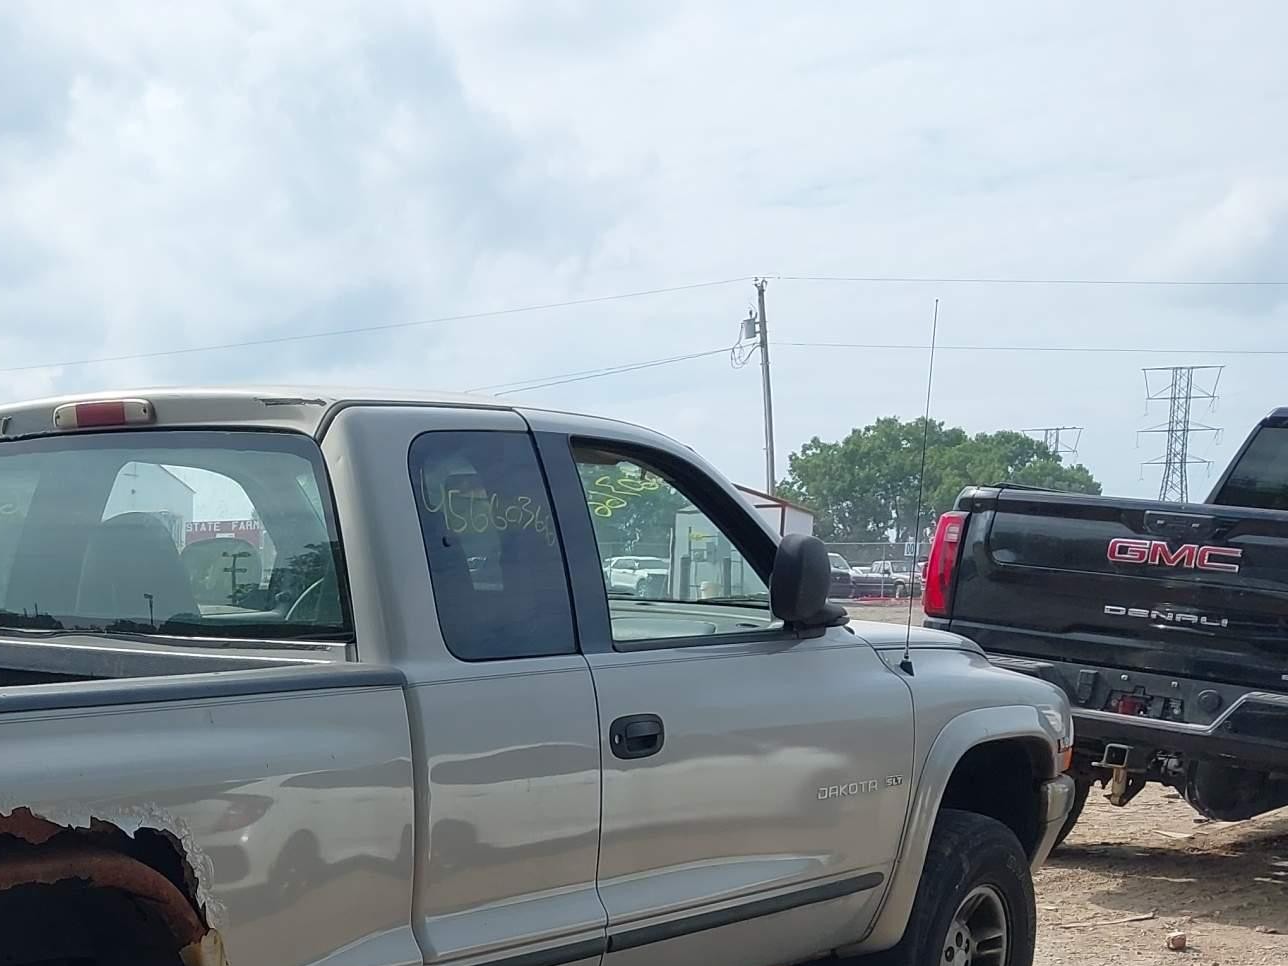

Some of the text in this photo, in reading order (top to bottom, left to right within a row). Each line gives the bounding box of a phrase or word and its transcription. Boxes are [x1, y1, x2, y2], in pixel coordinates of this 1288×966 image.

[185, 520, 260, 532] STATE FARM
[1107, 538, 1243, 573] GMC
[1104, 605, 1228, 628] DENALI
[818, 774, 904, 800] DAKOTA SLT
